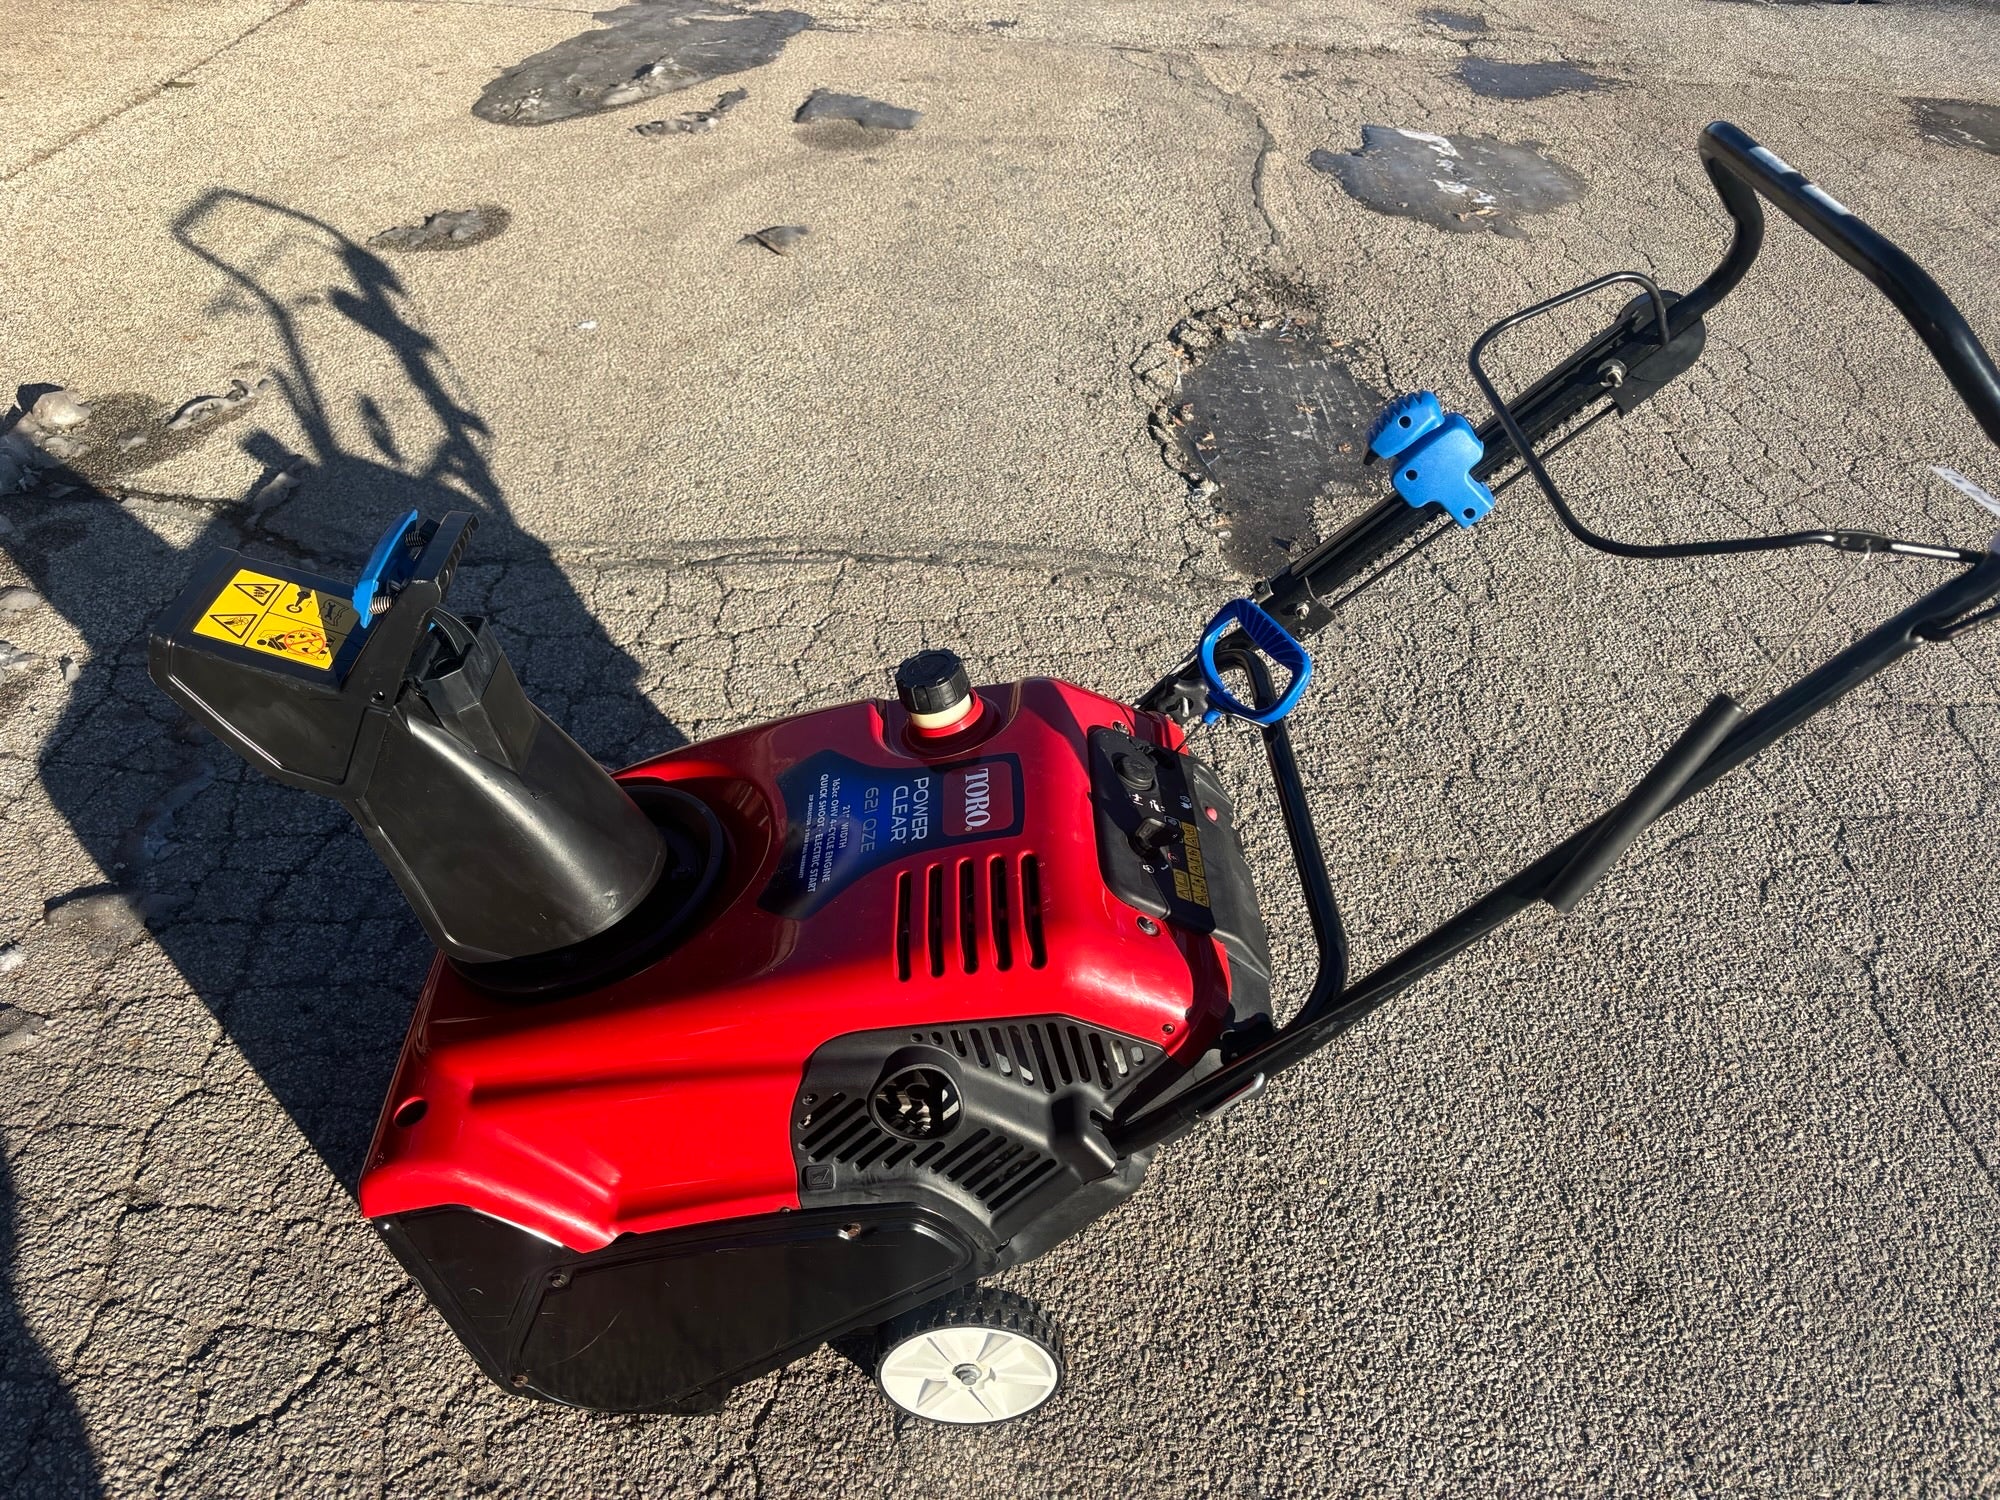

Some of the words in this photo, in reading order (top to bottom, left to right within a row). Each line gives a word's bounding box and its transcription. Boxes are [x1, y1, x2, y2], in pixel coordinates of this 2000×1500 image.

[820, 773, 829, 799] QUICK
[832, 778, 841, 798] 163cc
[865, 787, 879, 814] 621
[965, 767, 991, 827] TORO
[818, 800, 827, 828] SHOOT
[831, 799, 839, 817] OHV
[891, 785, 909, 842] CLEAR
[912, 776, 930, 842] POWER
[828, 819, 837, 849] 4-CYCLE
[839, 822, 849, 848] WIDTH
[862, 818, 877, 853] QZE
[812, 833, 823, 868] ELECTRIC
[808, 868, 818, 892] START
[822, 851, 833, 883] ENGINE
